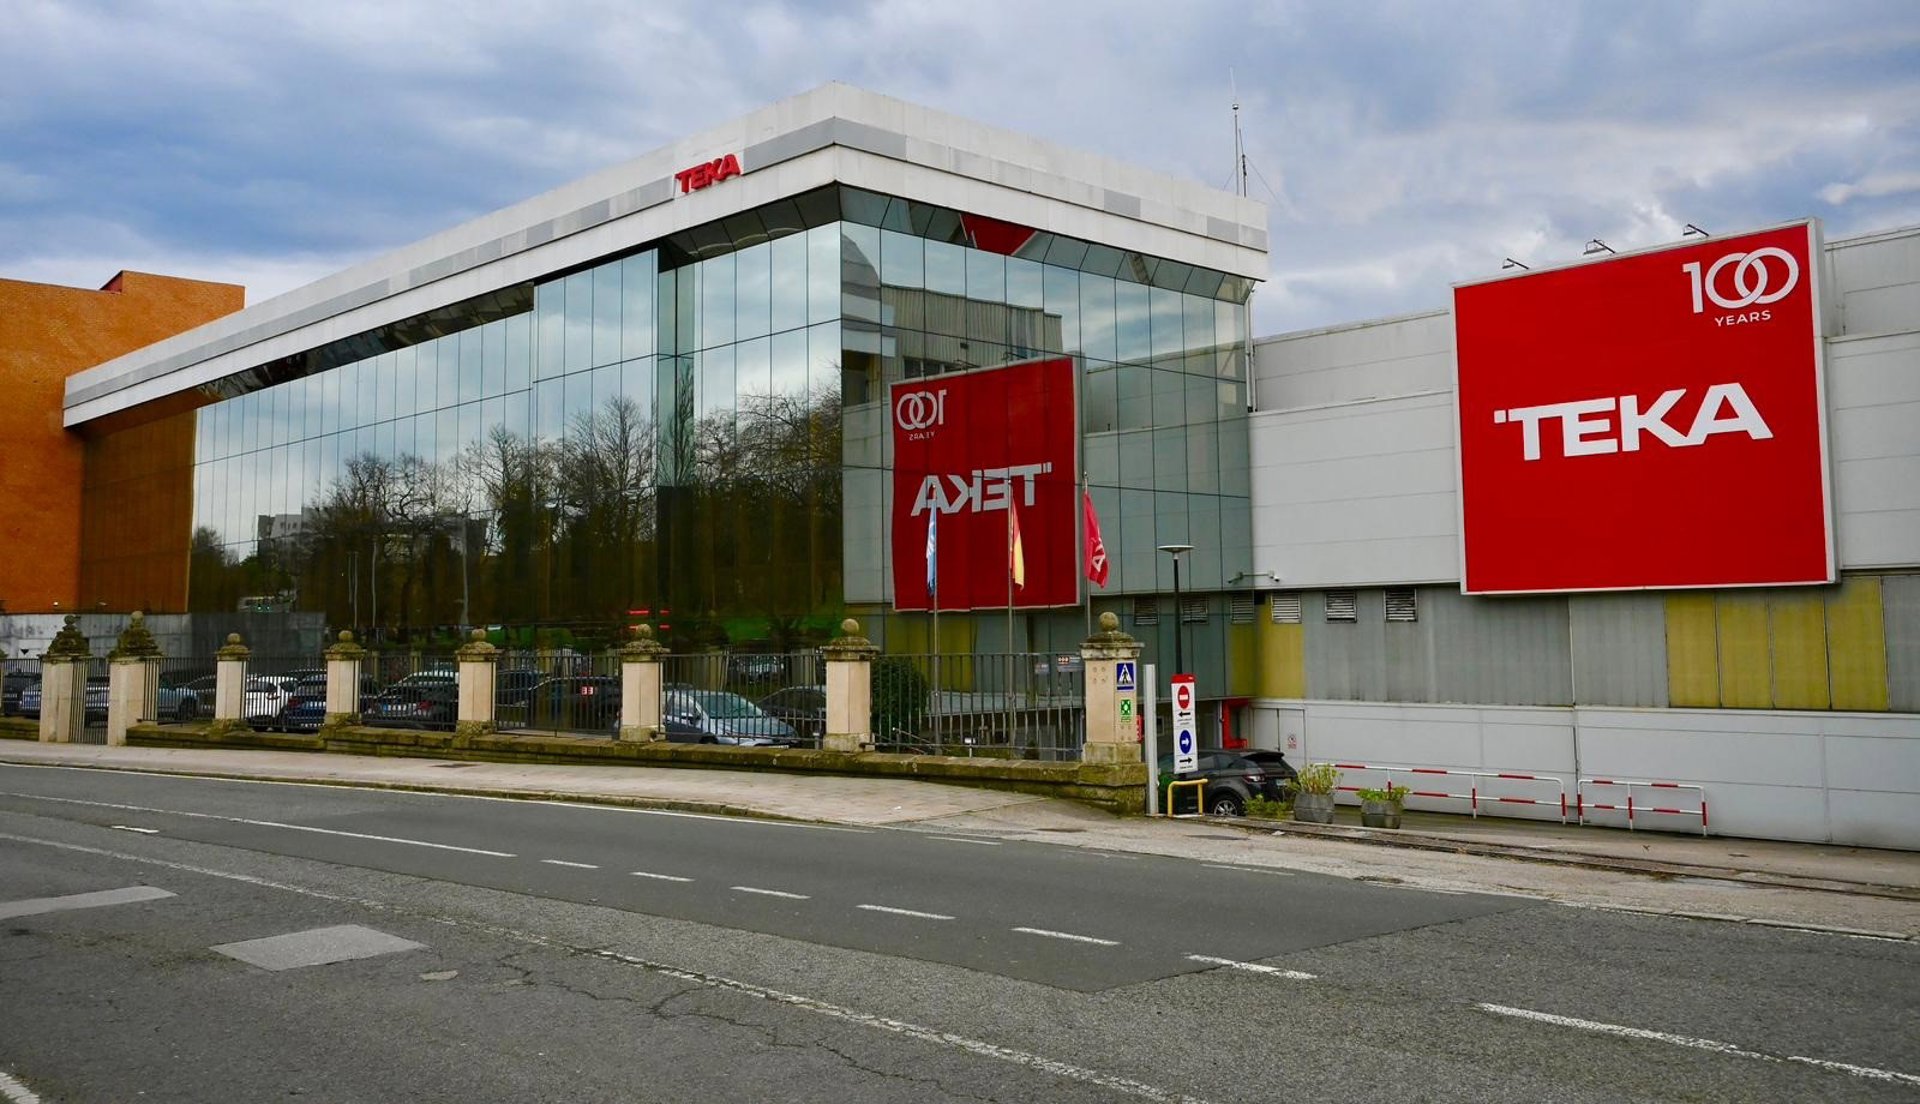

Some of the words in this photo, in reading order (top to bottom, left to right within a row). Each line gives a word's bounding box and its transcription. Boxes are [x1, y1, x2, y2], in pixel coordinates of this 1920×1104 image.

[676, 155, 741, 193] TEKA
[1682, 247, 1799, 314] 100
[1714, 309, 1772, 327] YEARS
[1507, 382, 1774, 461] TEKA
